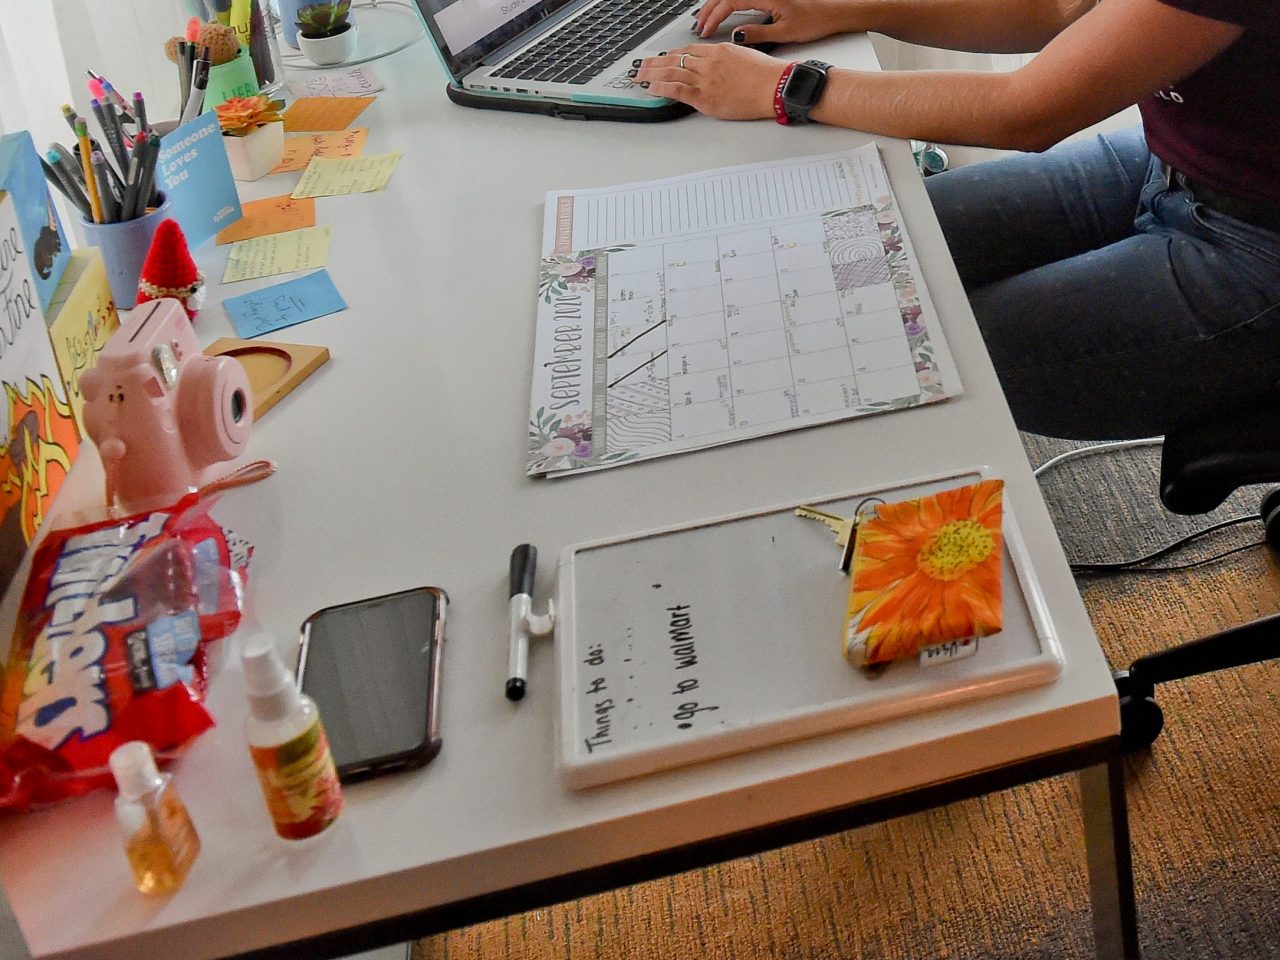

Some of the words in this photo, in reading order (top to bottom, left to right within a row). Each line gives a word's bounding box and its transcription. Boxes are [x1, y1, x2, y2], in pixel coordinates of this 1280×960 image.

[158, 123, 216, 164] Someone
[162, 148, 199, 178] Loves
[164, 169, 190, 191] You
[665, 604, 699, 670] walmart
[586, 677, 608, 695] to
[671, 678, 700, 696] to
[673, 701, 718, 721] go
[584, 698, 616, 754] Things
